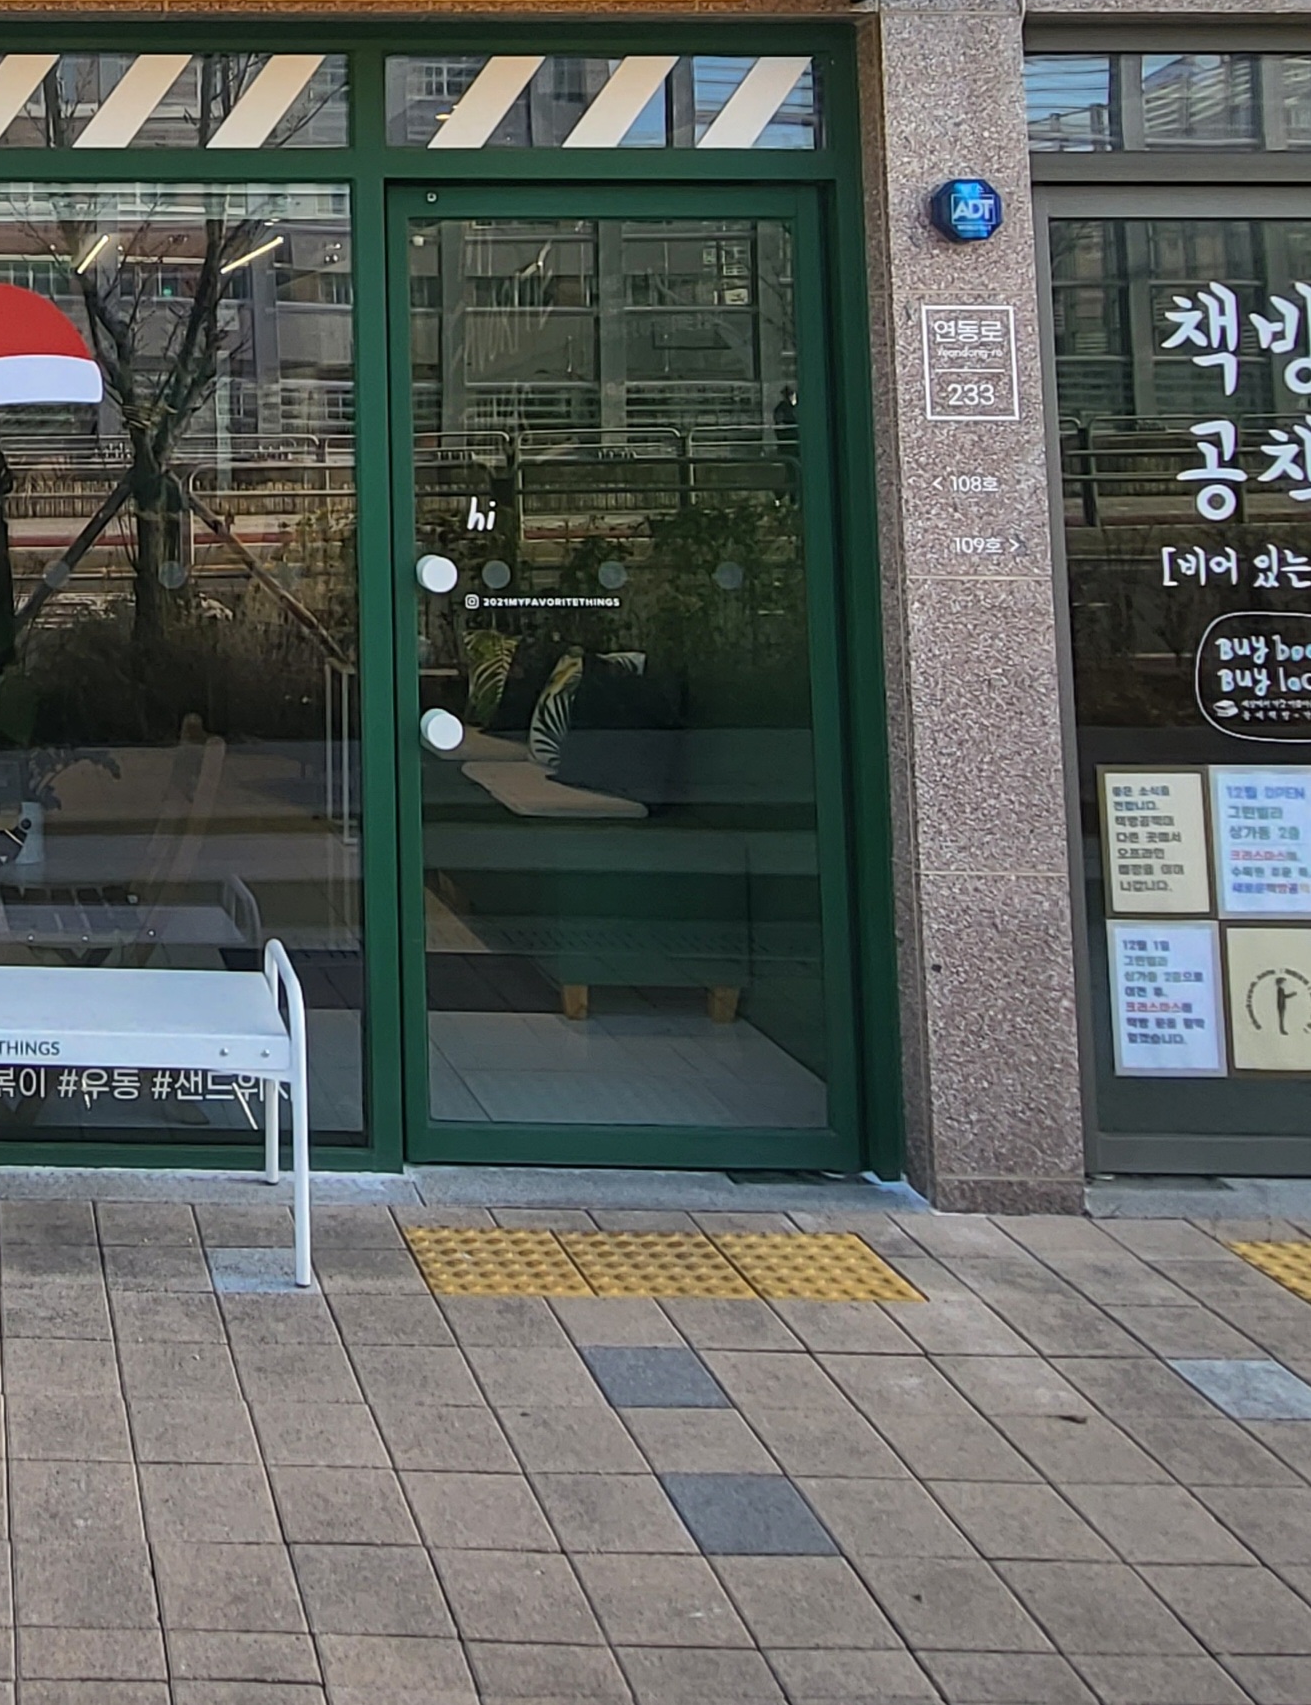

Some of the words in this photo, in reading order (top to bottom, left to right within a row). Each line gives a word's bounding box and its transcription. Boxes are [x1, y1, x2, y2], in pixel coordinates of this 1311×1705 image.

[952, 199, 994, 220] ADT
[934, 320, 1003, 342] 연동로
[947, 383, 995, 406] 233
[950, 475, 999, 492] 108호
[467, 496, 496, 531] hi
[953, 536, 1003, 553] 109호
[483, 598, 620, 607] 2021MYFAVORITETHINGS
[57, 1068, 141, 1100] #우동
[151, 1070, 288, 1102] #샌드위
